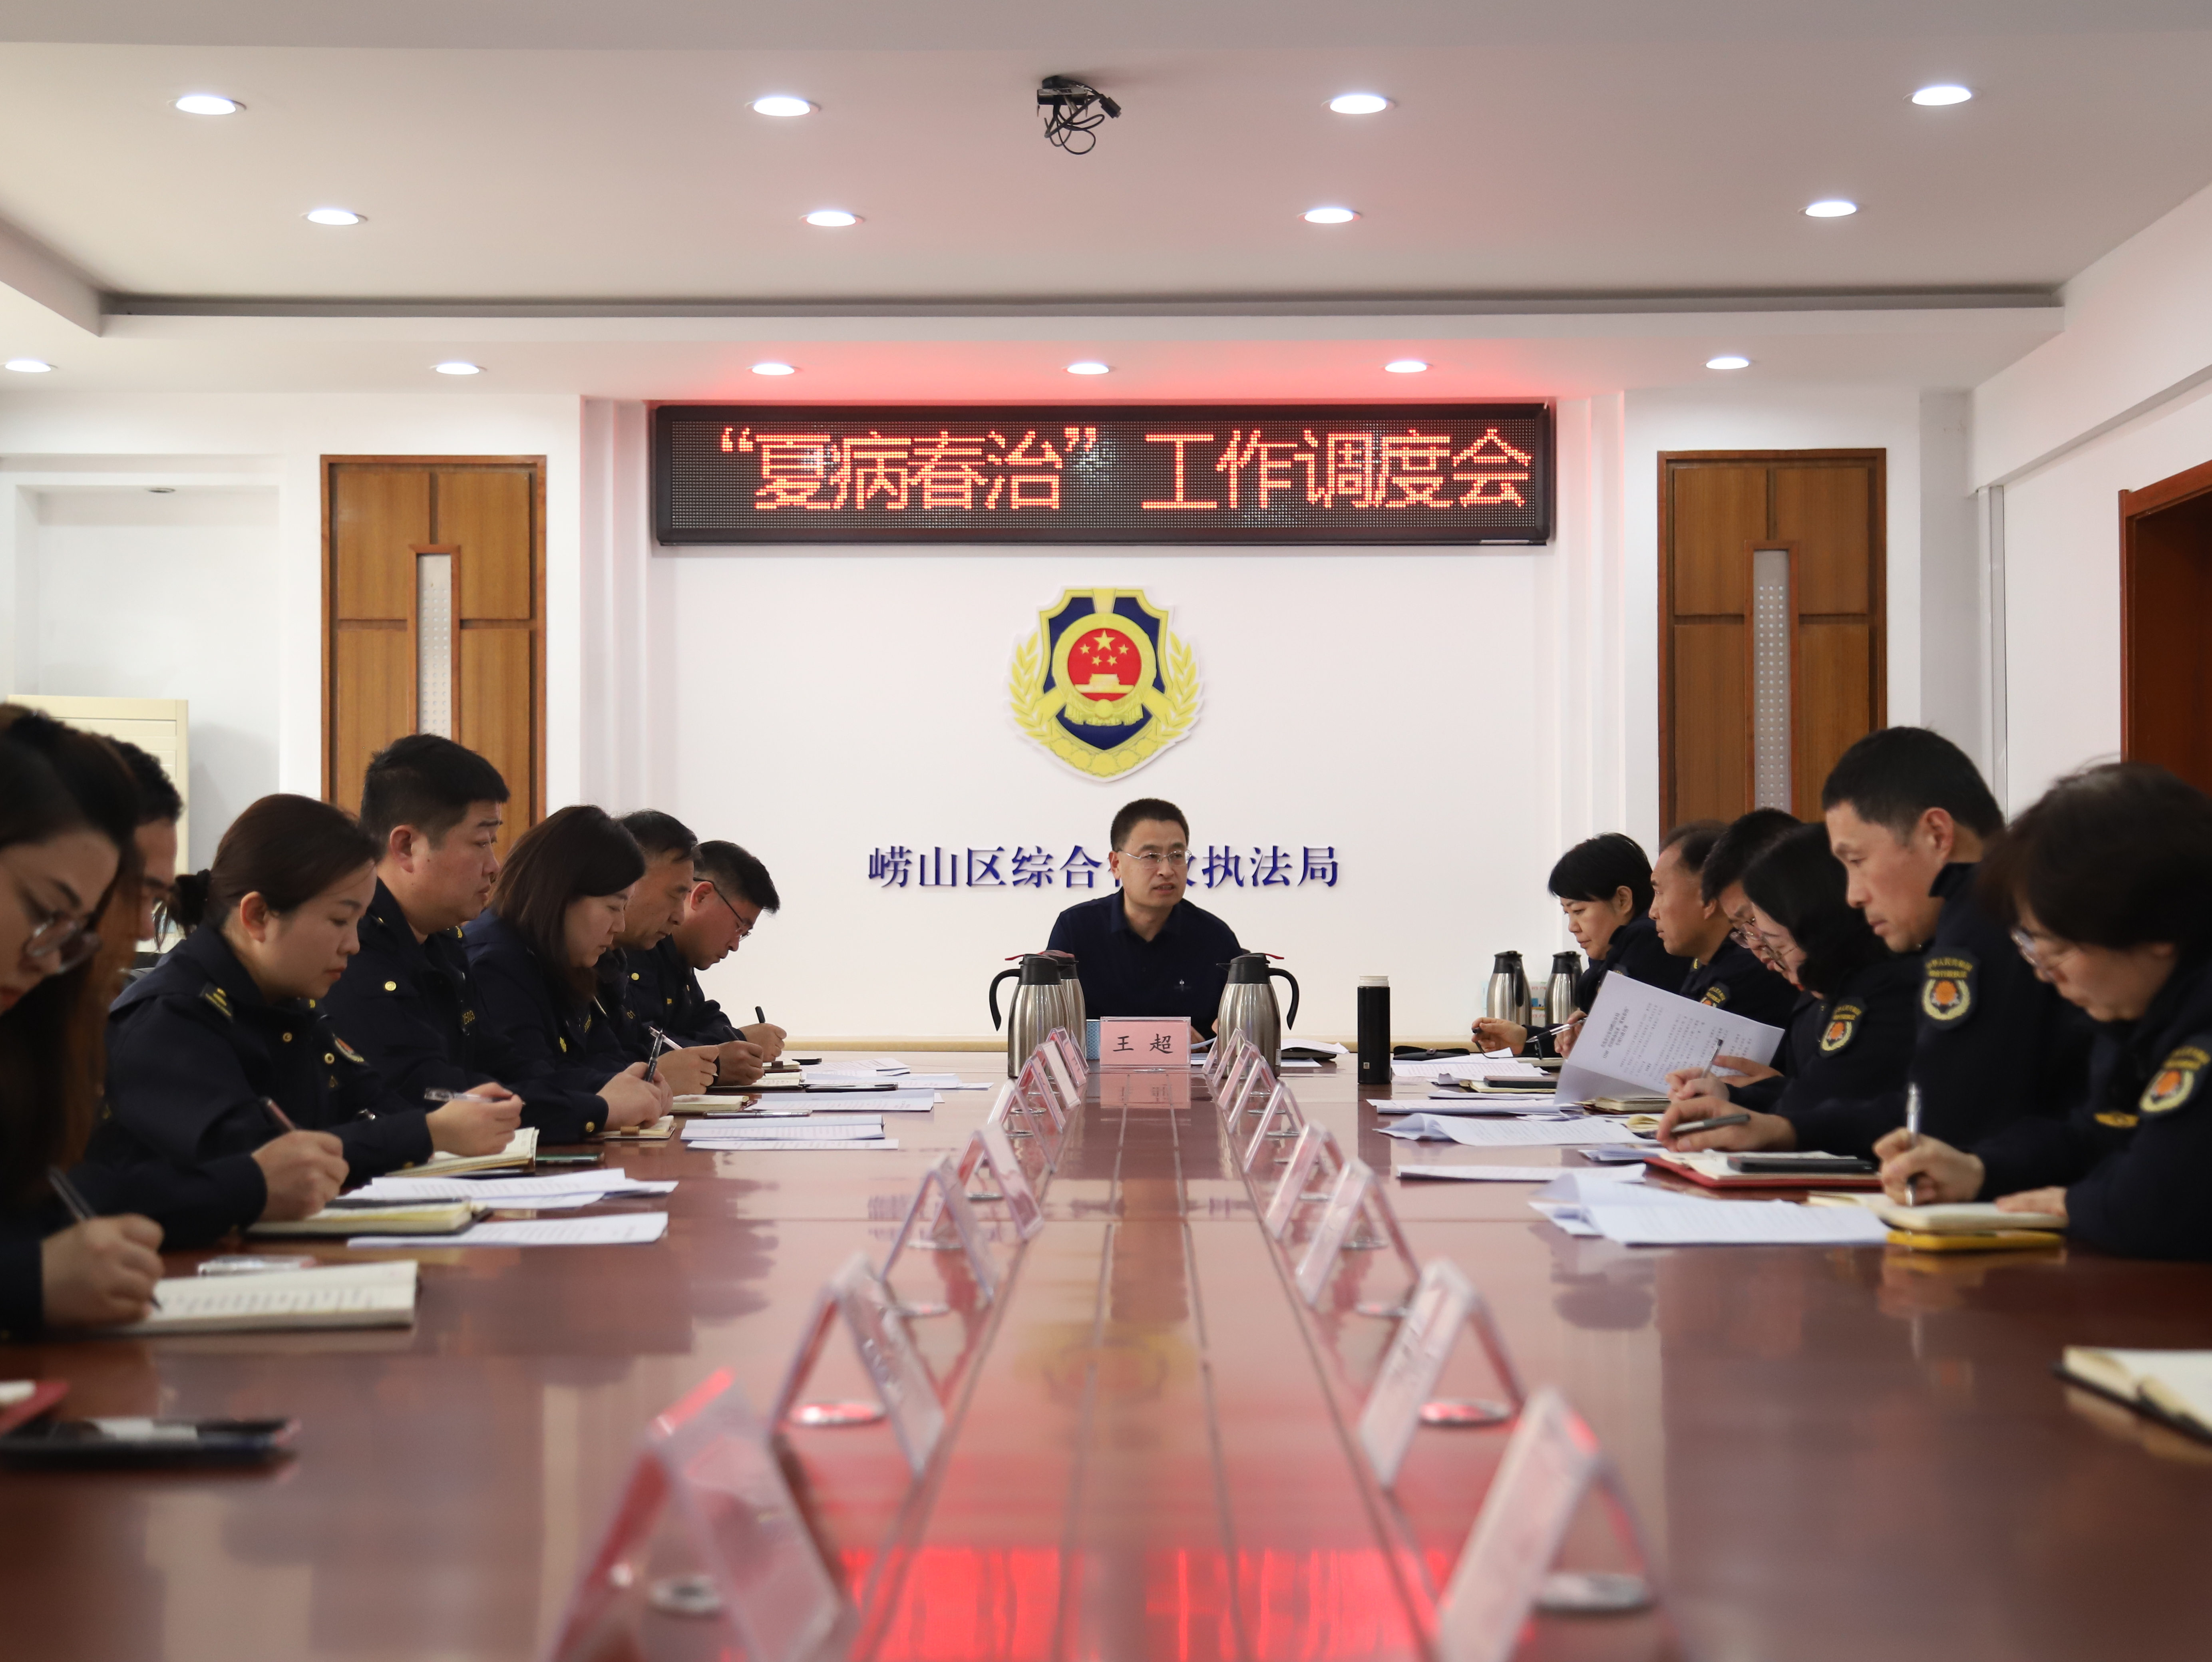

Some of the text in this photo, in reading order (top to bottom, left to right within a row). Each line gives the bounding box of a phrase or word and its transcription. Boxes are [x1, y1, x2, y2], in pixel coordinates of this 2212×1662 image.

[721, 427, 1532, 510] “夏病春治” 工作调度会
[869, 845, 1339, 888] 崂山区综合执法局
